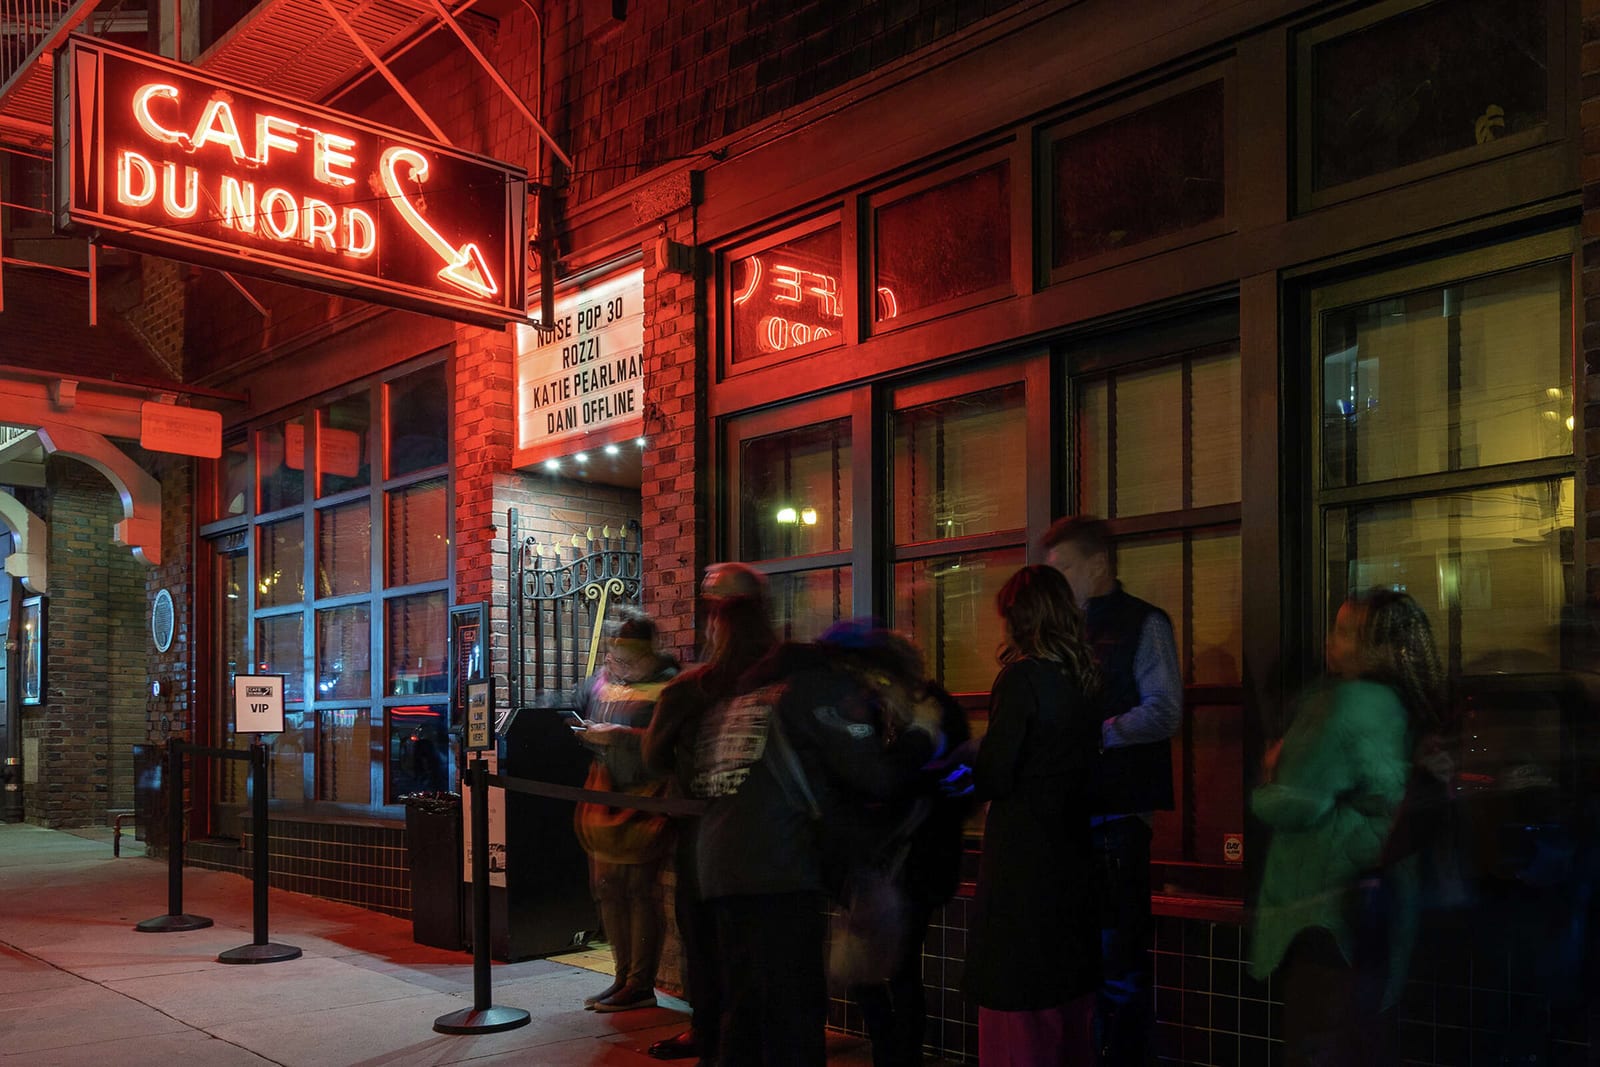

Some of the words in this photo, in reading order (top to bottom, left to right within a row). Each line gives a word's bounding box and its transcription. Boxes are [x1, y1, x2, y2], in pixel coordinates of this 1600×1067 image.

[132, 83, 357, 187] CAFE
[117, 151, 200, 219] DU
[219, 175, 377, 258] NORD
[577, 304, 602, 333] POP
[607, 297, 623, 323] 30
[562, 336, 600, 369] ROZZI
[533, 376, 570, 408] KATIE
[547, 405, 577, 434] DANI
[583, 389, 635, 424] OFFLINE
[250, 703, 269, 713] VIP
